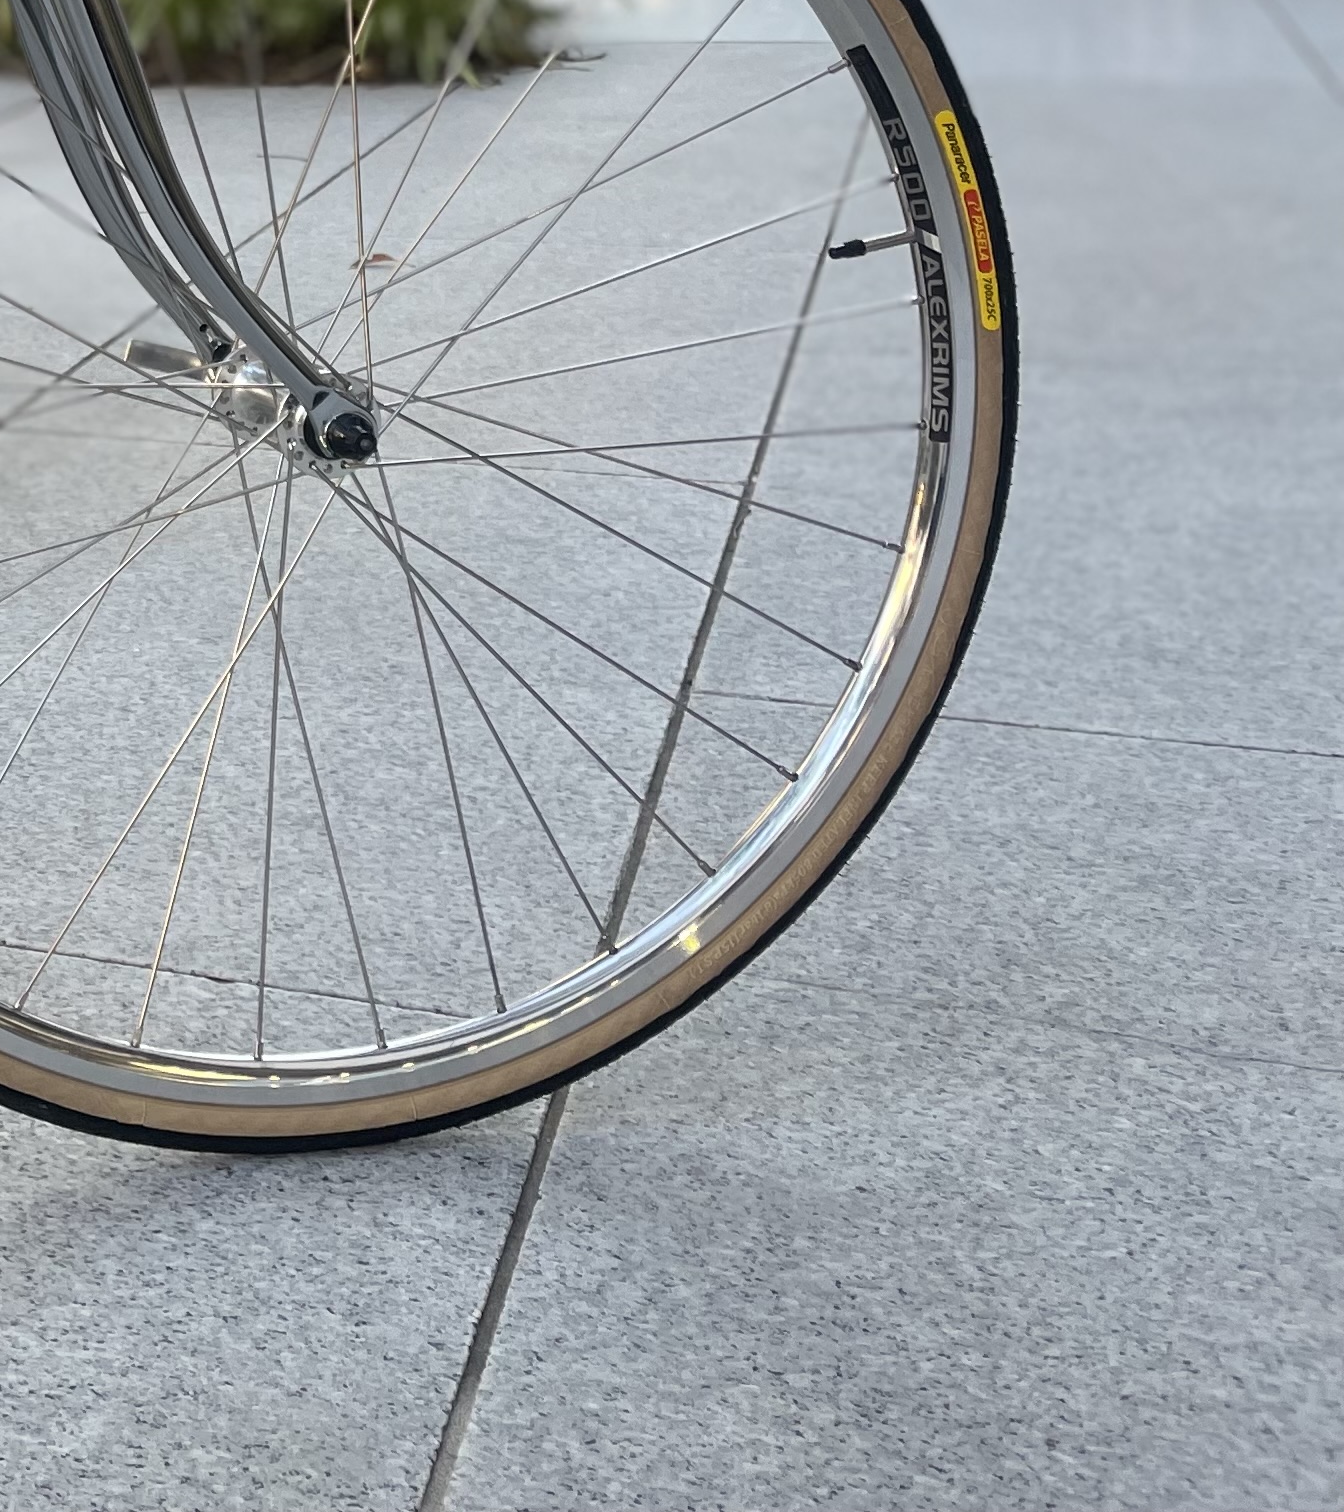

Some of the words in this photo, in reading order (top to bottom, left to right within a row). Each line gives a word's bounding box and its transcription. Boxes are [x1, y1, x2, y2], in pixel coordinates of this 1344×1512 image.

[882, 117, 932, 222] R500
[922, 255, 951, 432] ALEXRIMS
[942, 123, 971, 184] Panaracer
[970, 215, 990, 261] PASELA
